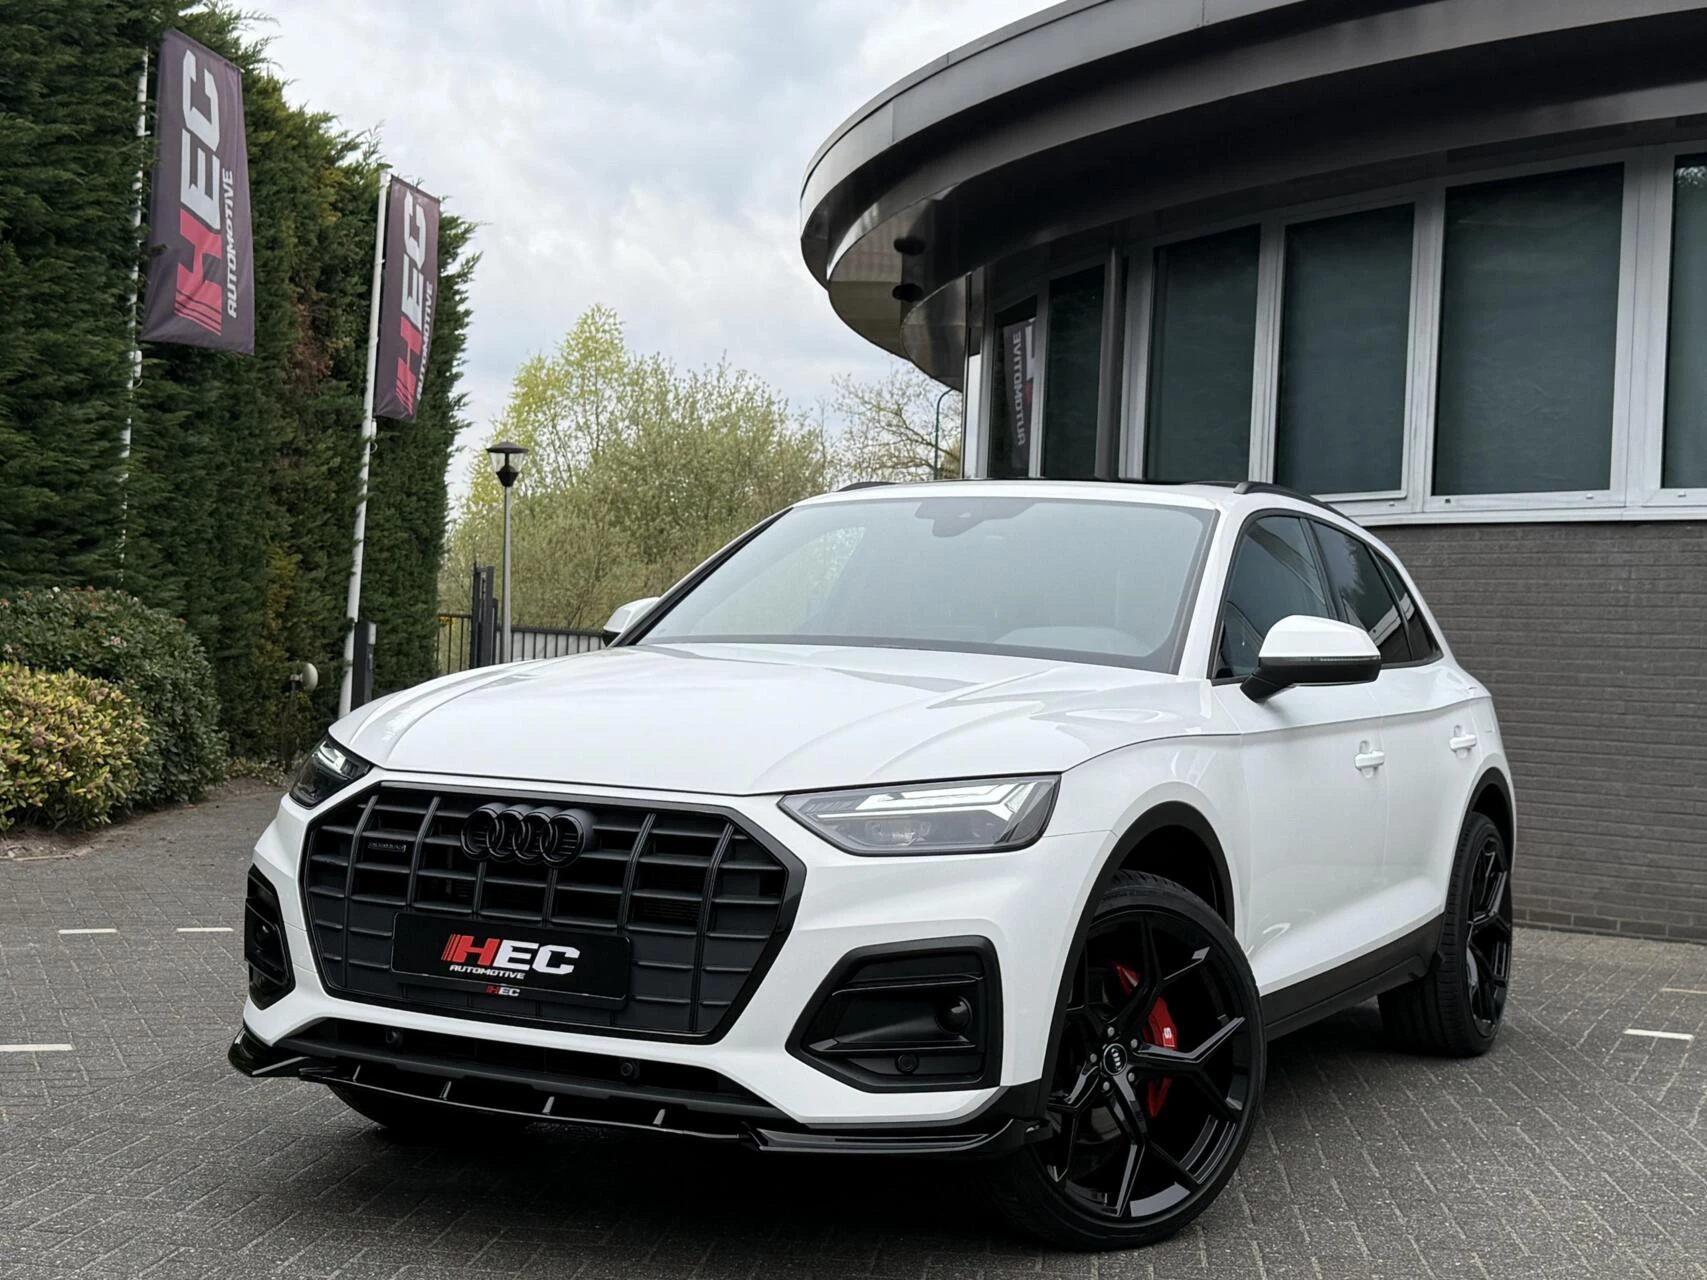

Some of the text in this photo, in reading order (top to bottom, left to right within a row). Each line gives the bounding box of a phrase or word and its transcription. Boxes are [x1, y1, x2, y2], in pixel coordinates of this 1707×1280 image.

[175, 49, 223, 336] HEC
[223, 168, 237, 318] AUTOMOTIVE
[395, 189, 427, 416] HEC
[441, 933, 581, 976] HEC
[449, 964, 527, 980] AUTOMOTIVE
[485, 983, 521, 997] HEC
